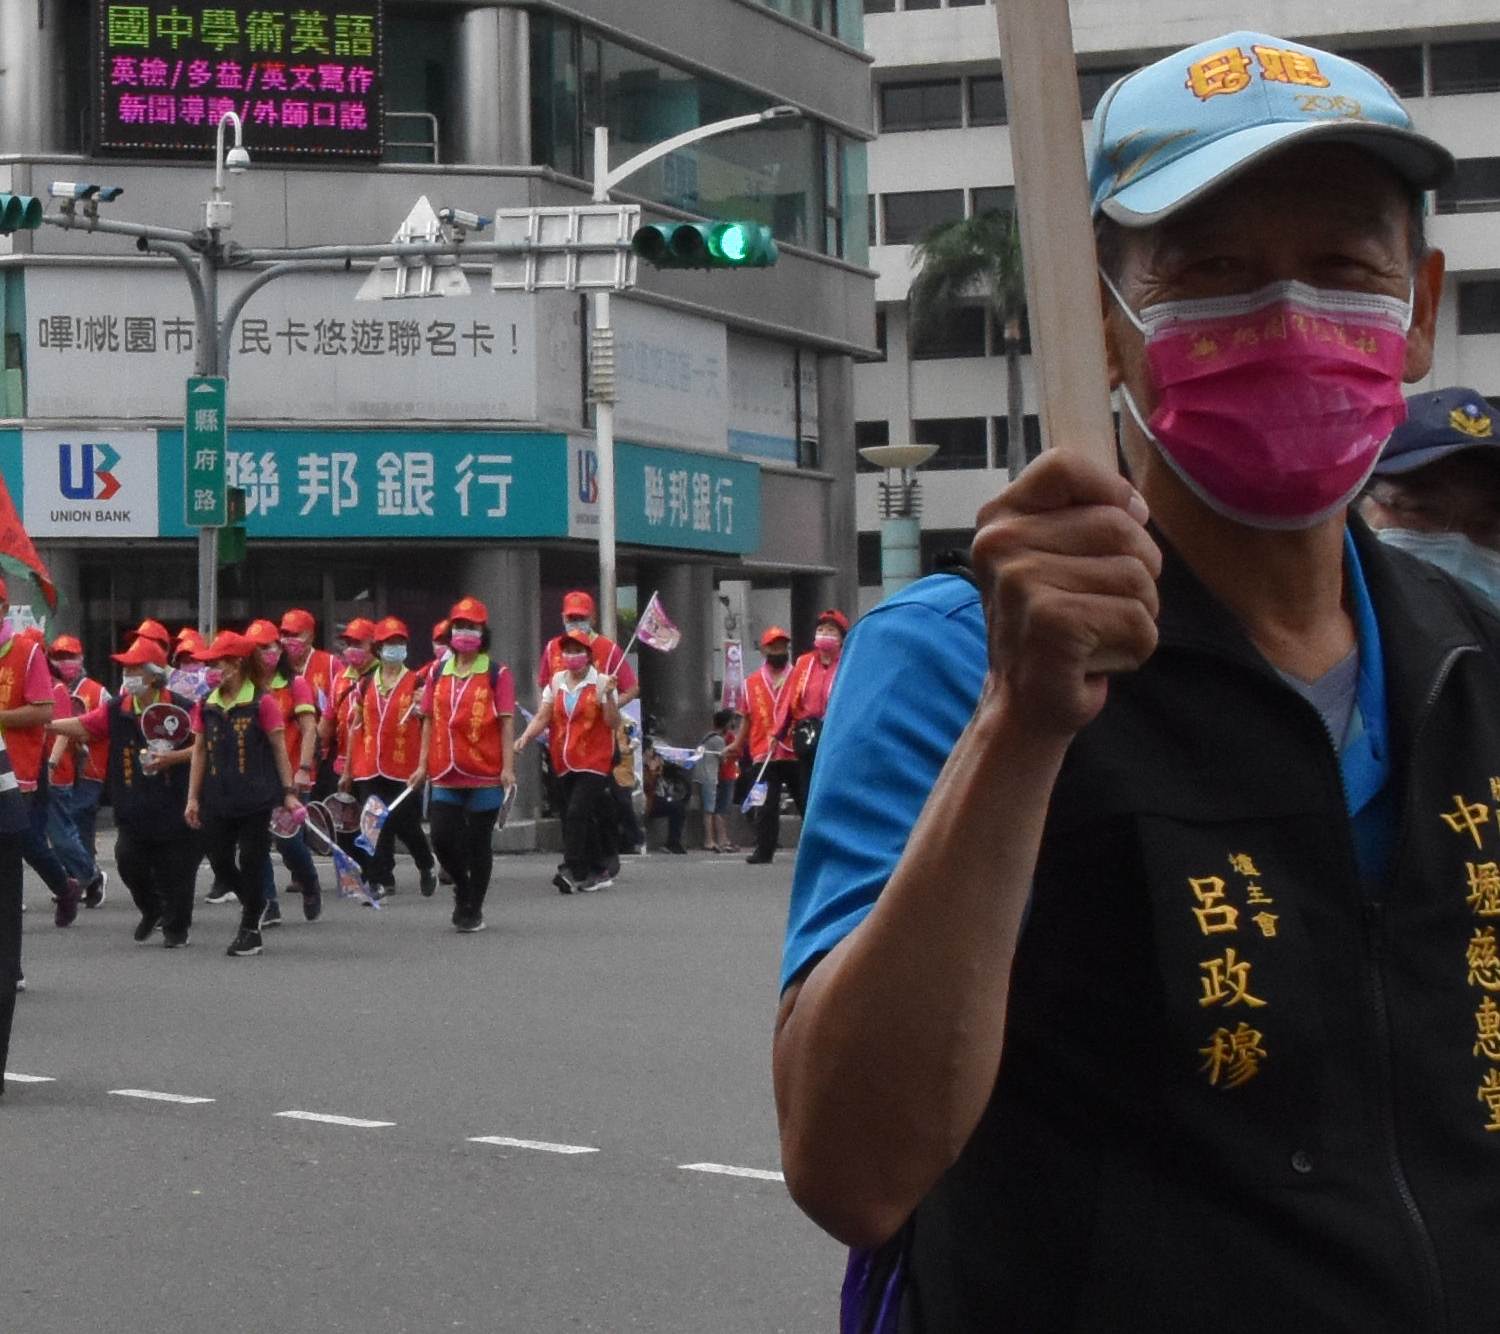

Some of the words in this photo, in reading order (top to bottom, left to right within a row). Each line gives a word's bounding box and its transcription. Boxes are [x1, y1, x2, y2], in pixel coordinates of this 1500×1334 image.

[108, 5, 375, 57] 國中學術英語
[37, 313, 519, 359] 嗶!桃園市民卡悠遊聯名卡!
[193, 408, 219, 513] 縣府路
[224, 450, 514, 519] 聯邦銀行
[50, 510, 92, 524] UNION
[95, 510, 132, 524] BANK
[643, 464, 735, 536] 聯邦銀行
[1186, 874, 1270, 1091] 呂政穆
